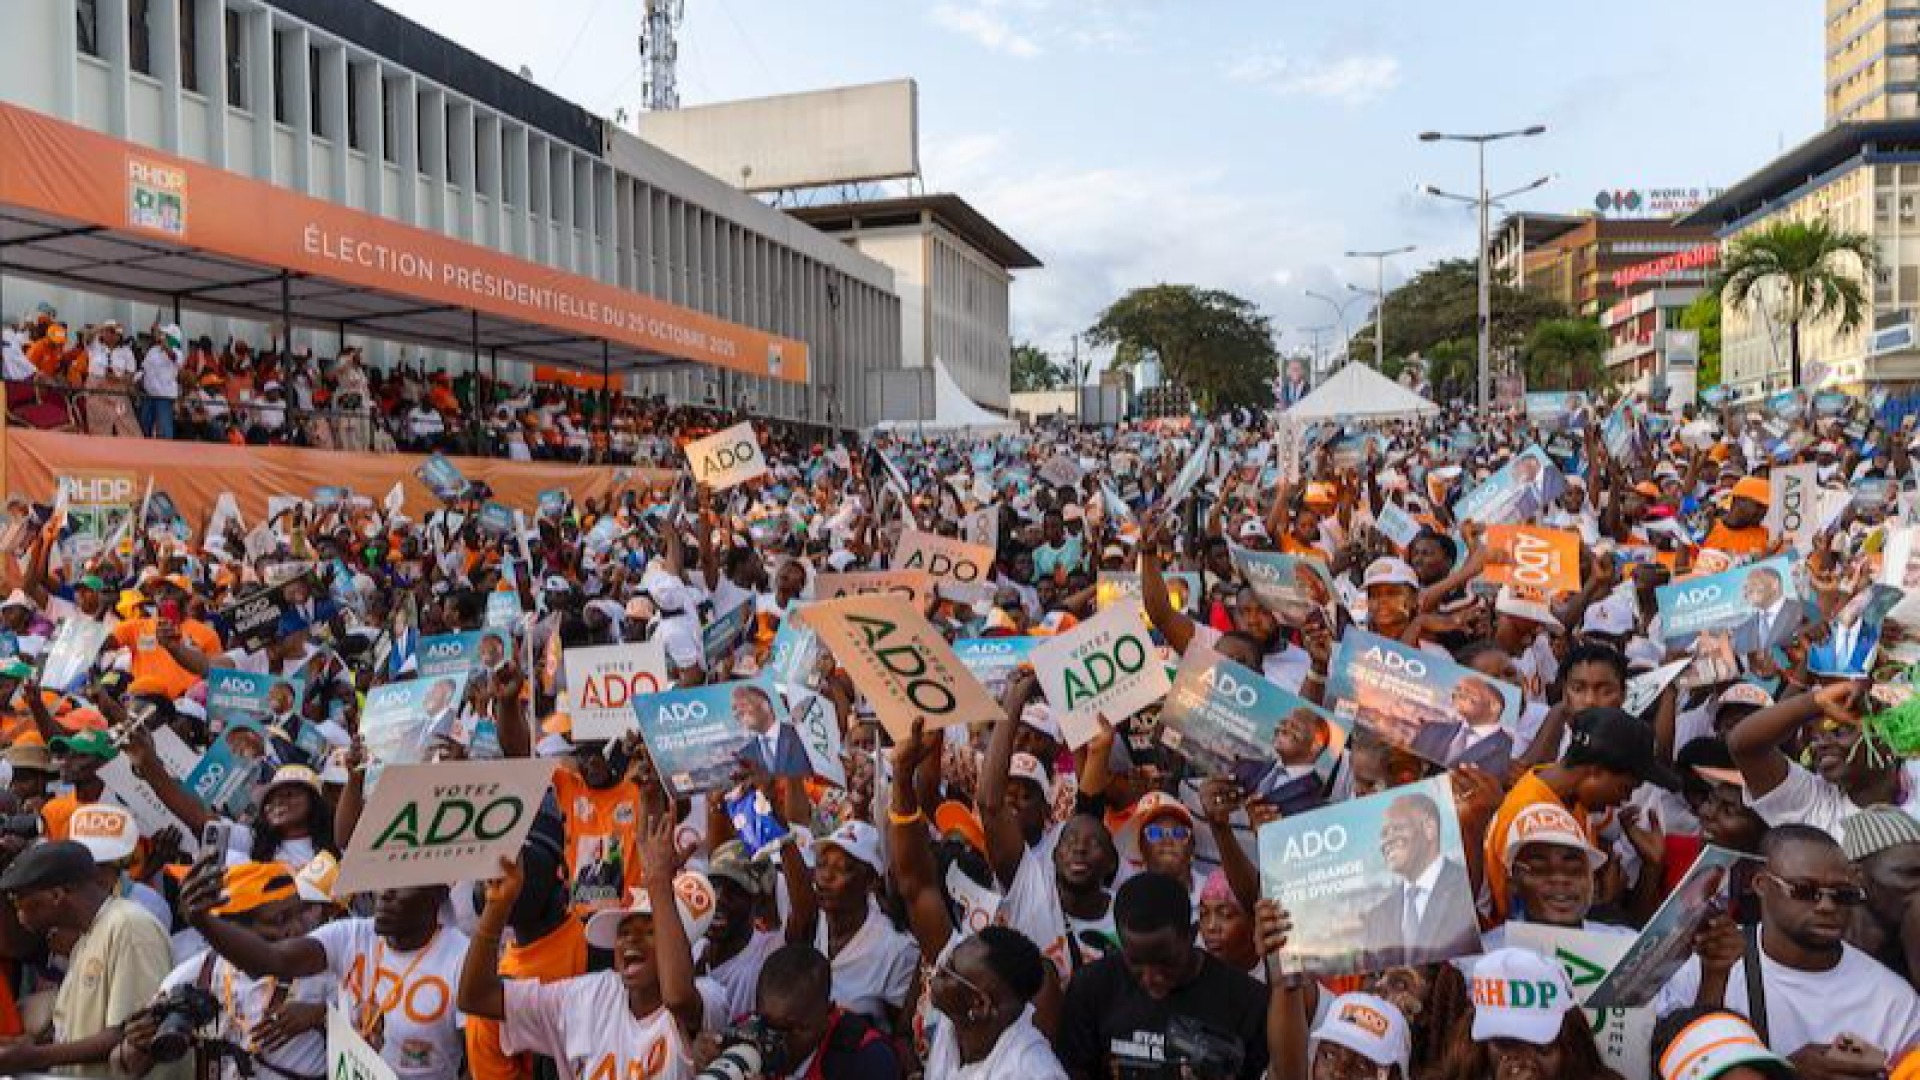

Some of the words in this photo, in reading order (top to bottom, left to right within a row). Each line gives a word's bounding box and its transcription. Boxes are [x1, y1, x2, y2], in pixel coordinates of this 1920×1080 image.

[129, 160, 187, 188] RHDP
[303, 222, 433, 282] ÉLECTION
[443, 262, 599, 322] PRÉSIDENTIELLE
[602, 305, 625, 328] DU
[648, 318, 708, 350] OCTOBRE
[702, 440, 754, 477] ADO
[905, 549, 978, 582] ADO
[1514, 532, 1549, 583] ADO
[1676, 587, 1722, 606] ADO
[428, 640, 463, 657] ADO
[845, 613, 957, 715] ADO
[966, 642, 1013, 655] ADO
[1365, 644, 1427, 678] ADO
[220, 677, 255, 694] ADO
[581, 671, 659, 708] ADO
[1063, 633, 1146, 712] ADO
[1199, 666, 1258, 707] ADO
[659, 700, 708, 724] ADO
[194, 763, 224, 798] ADO
[434, 782, 500, 798] VOTEZ
[75, 813, 122, 832] ADO
[371, 796, 524, 851] ADO
[1282, 824, 1347, 865] ADO
[343, 953, 451, 1024] ADO
[1472, 975, 1558, 1009] RHDP
[1607, 1003, 1626, 1057] OTEZ
